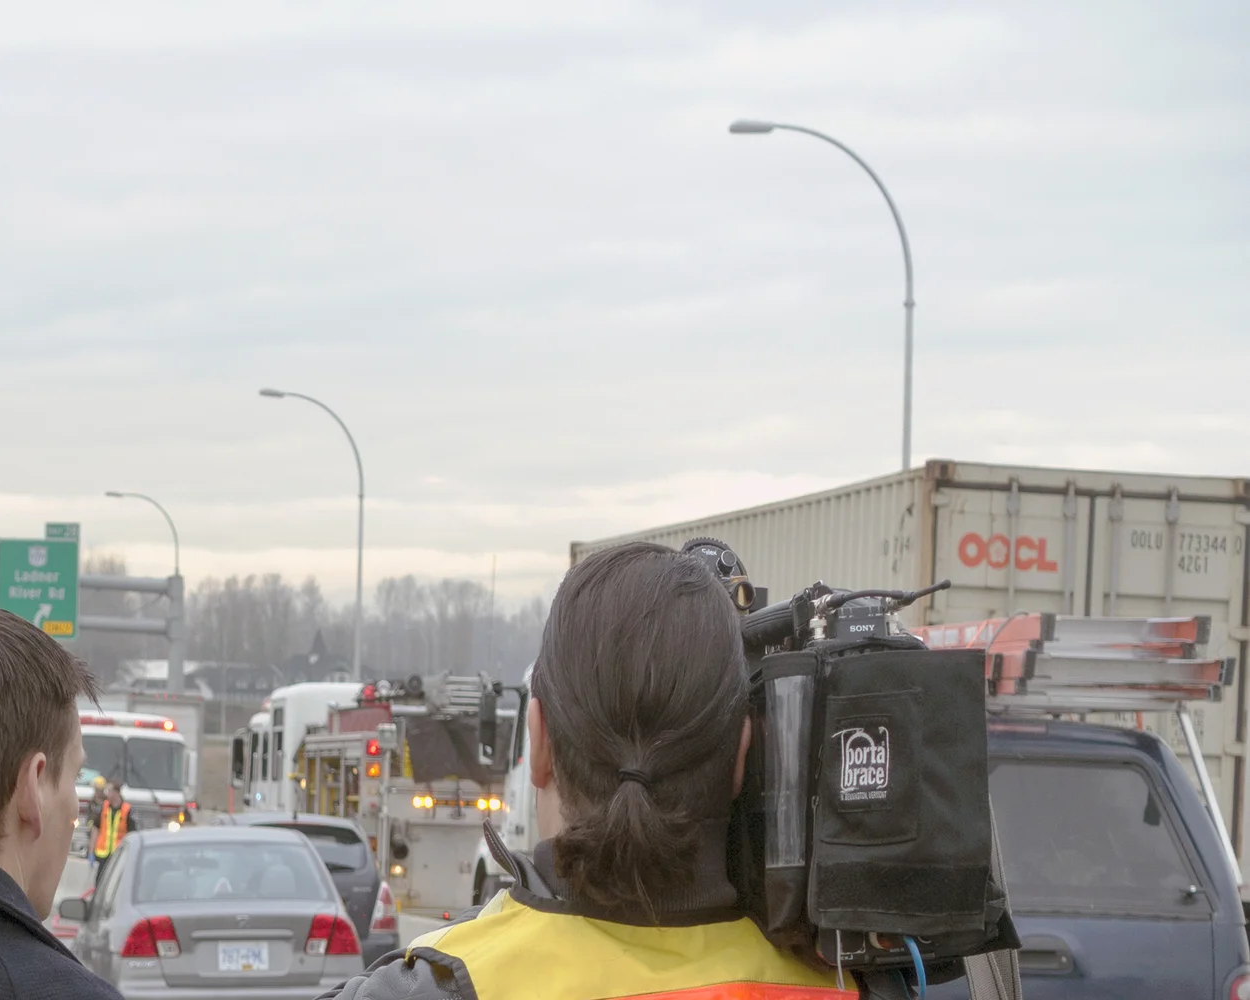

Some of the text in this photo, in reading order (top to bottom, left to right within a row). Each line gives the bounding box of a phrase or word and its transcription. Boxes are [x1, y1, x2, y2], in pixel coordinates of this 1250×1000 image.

[958, 532, 1059, 572] OOCL
[1178, 532, 1227, 555] 773344
[1177, 554, 1208, 574] 42G1
[14, 569, 59, 583] Ladner
[9, 585, 65, 600] River Rd
[849, 624, 876, 633] SONY
[846, 745, 886, 767] porta
[845, 766, 885, 787] brace
